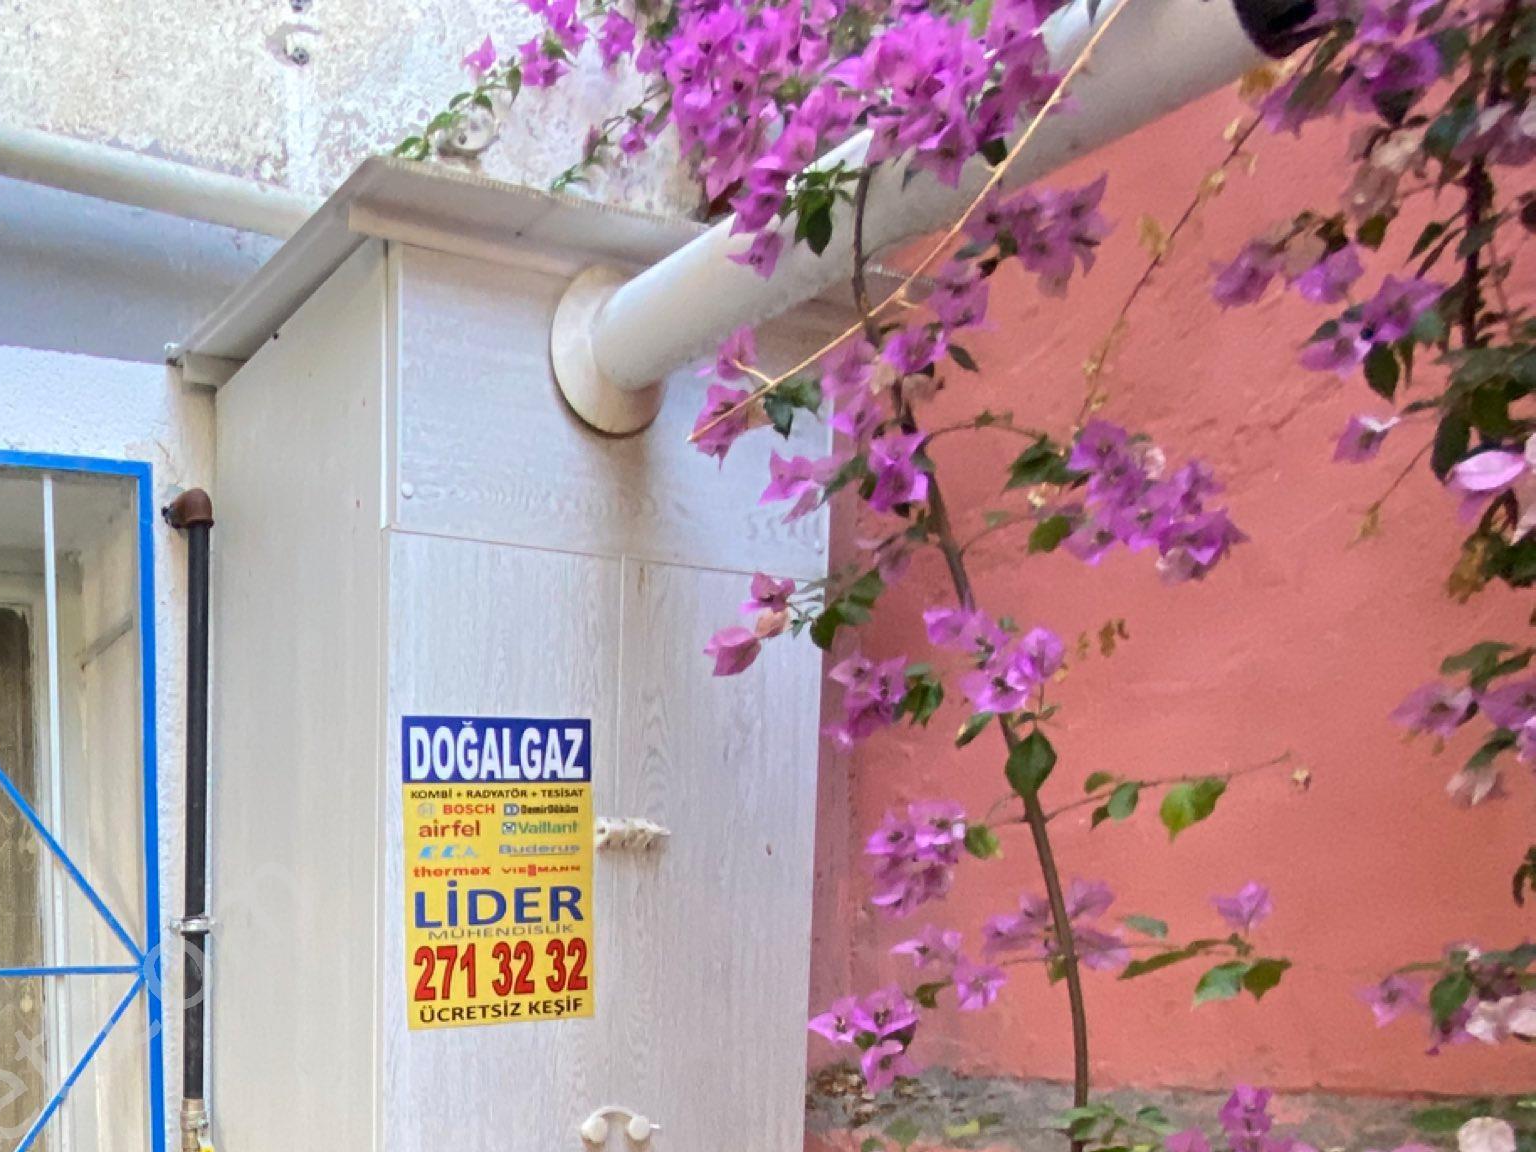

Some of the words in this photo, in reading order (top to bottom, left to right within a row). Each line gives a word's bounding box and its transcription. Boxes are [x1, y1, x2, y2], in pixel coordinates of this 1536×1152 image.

[409, 720, 584, 780] DOĞALGAZ
[410, 788, 453, 799] KOMBİ
[466, 788, 528, 799] RADYATÖR
[540, 787, 584, 798] TESİSAT
[442, 803, 496, 815] BOSCH
[418, 818, 481, 838] airfel
[518, 820, 579, 834] Vaillant
[414, 879, 584, 929] LİDER
[427, 923, 575, 941] MÜHENDİSLİK
[413, 942, 477, 1002] 271
[491, 940, 535, 997] 32
[545, 937, 589, 993] 32
[419, 999, 522, 1023] ÜCRETSİZ
[528, 995, 583, 1016] KEŞİF
